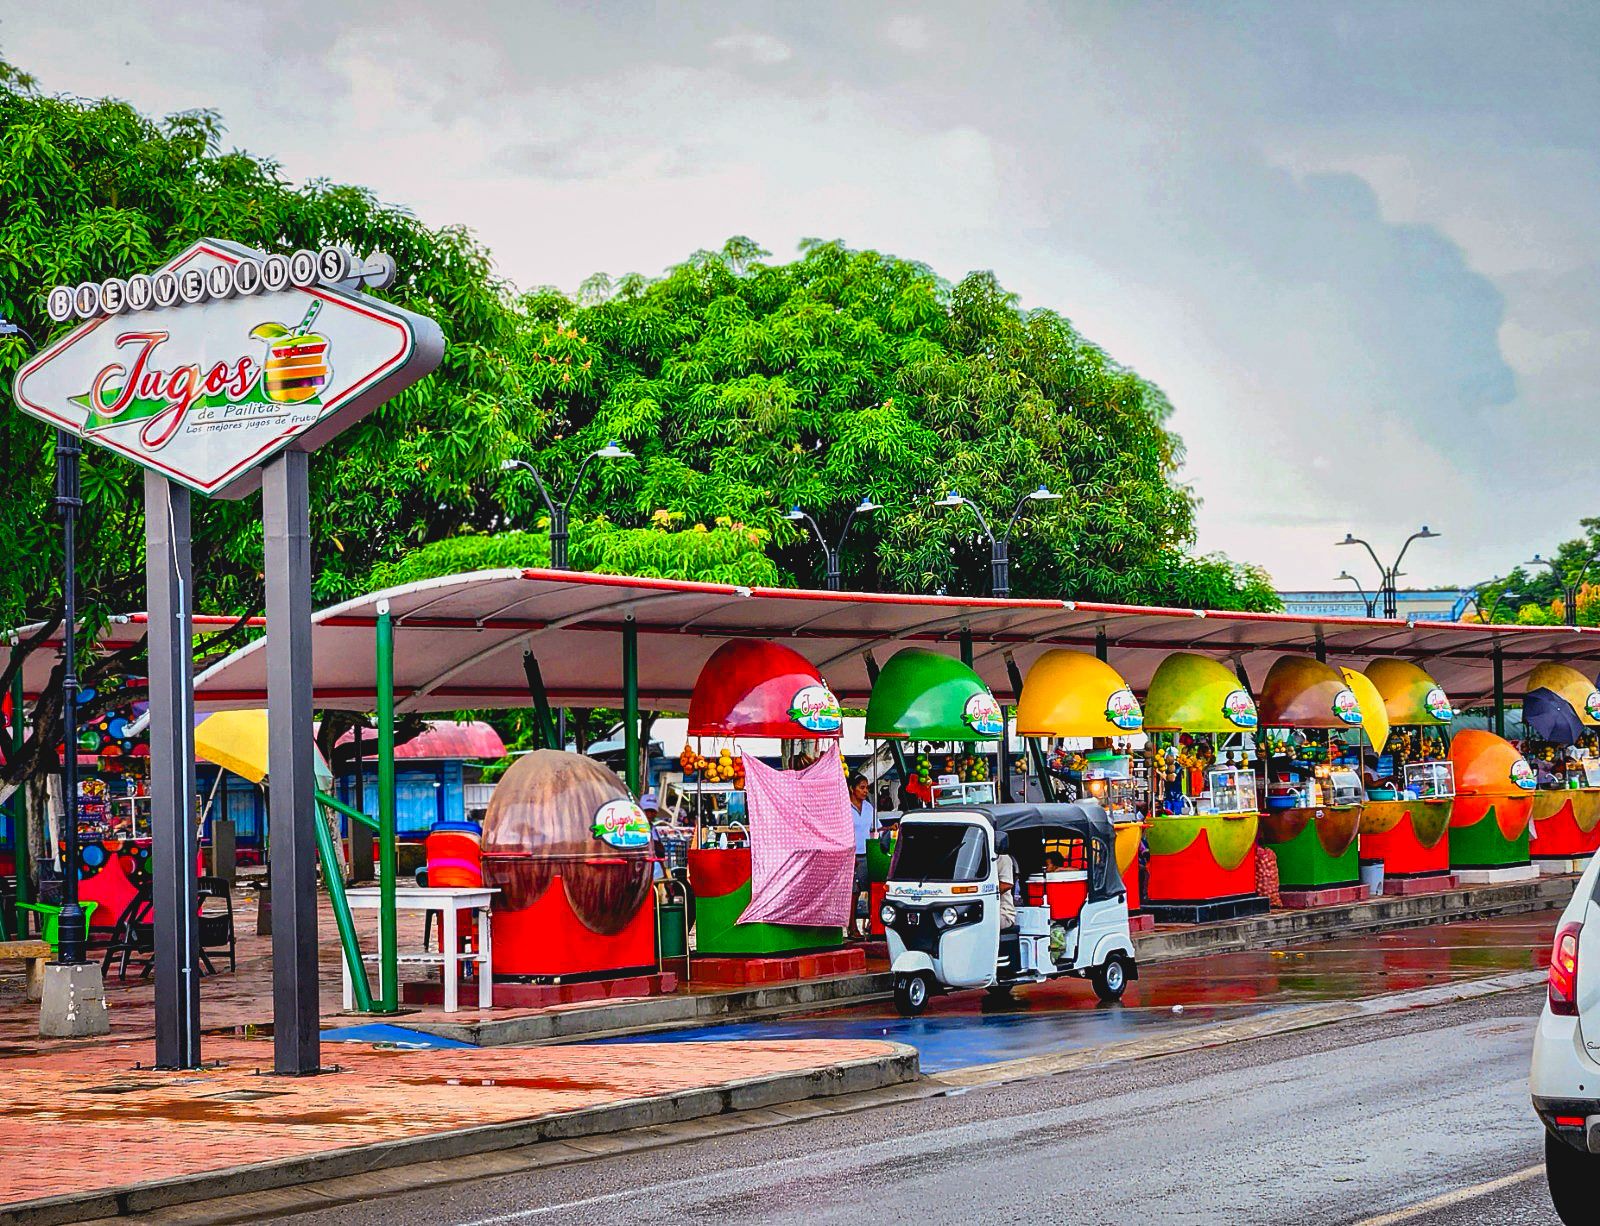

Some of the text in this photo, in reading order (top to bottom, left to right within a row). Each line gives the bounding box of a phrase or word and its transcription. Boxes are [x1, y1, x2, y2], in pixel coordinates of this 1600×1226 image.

[51, 248, 342, 318] BIENVENIDOS
[93, 331, 261, 447] Jugos
[197, 402, 281, 420] de Pailitas
[186, 425, 202, 433] Los
[207, 422, 242, 432] mejores
[245, 419, 270, 430] jugos
[275, 416, 286, 425] de
